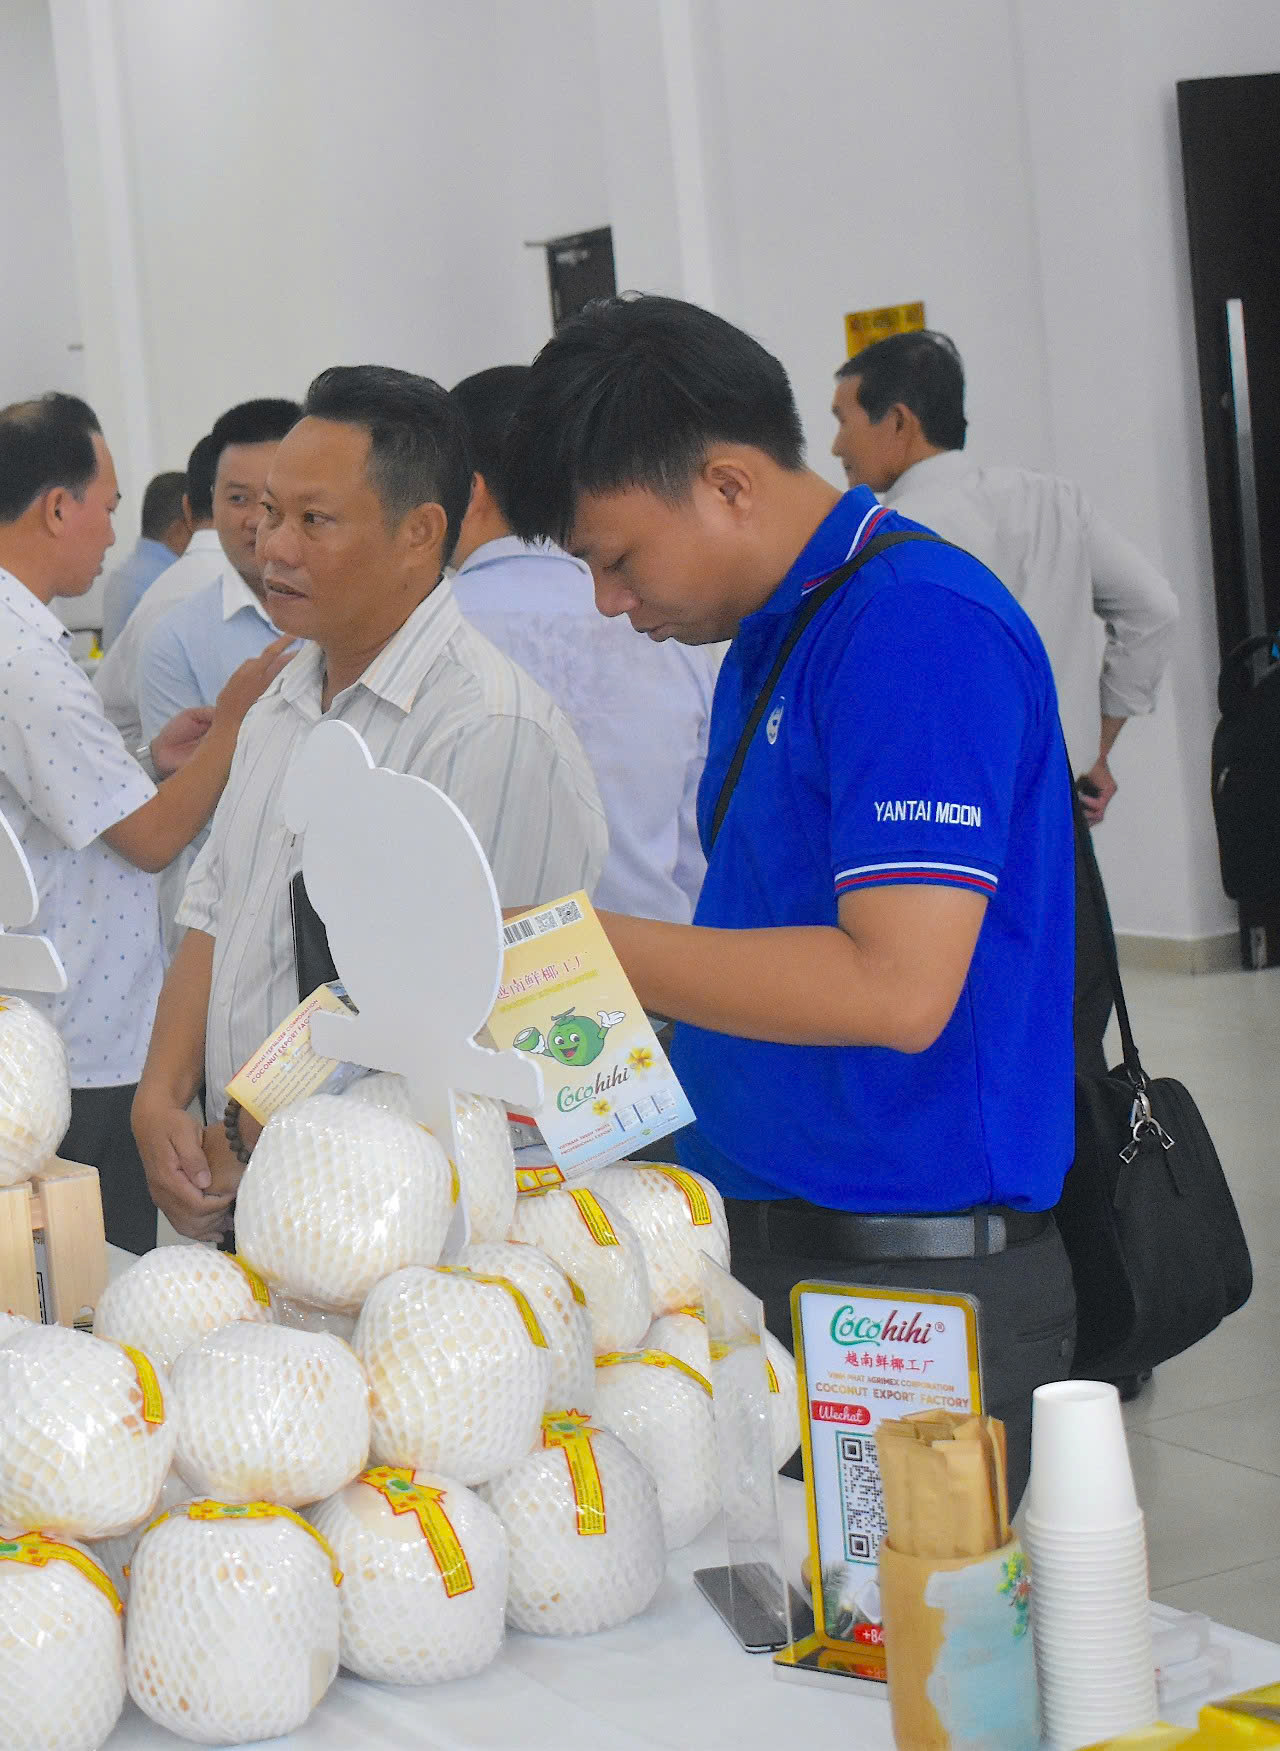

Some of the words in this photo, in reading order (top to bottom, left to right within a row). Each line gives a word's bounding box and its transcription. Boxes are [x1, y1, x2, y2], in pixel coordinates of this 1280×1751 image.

[874, 800, 930, 822] YANTAI
[935, 802, 982, 827] MOON
[251, 1053, 279, 1084] COCONUT
[556, 1064, 631, 1113] Cocohihi
[844, 1350, 935, 1373] 越南鲜椰工厂
[815, 1382, 868, 1397] COCONUT
[873, 1388, 915, 1402] EXPORT
[920, 1394, 969, 1408] FACTORY
[819, 1405, 863, 1423] Wechat
